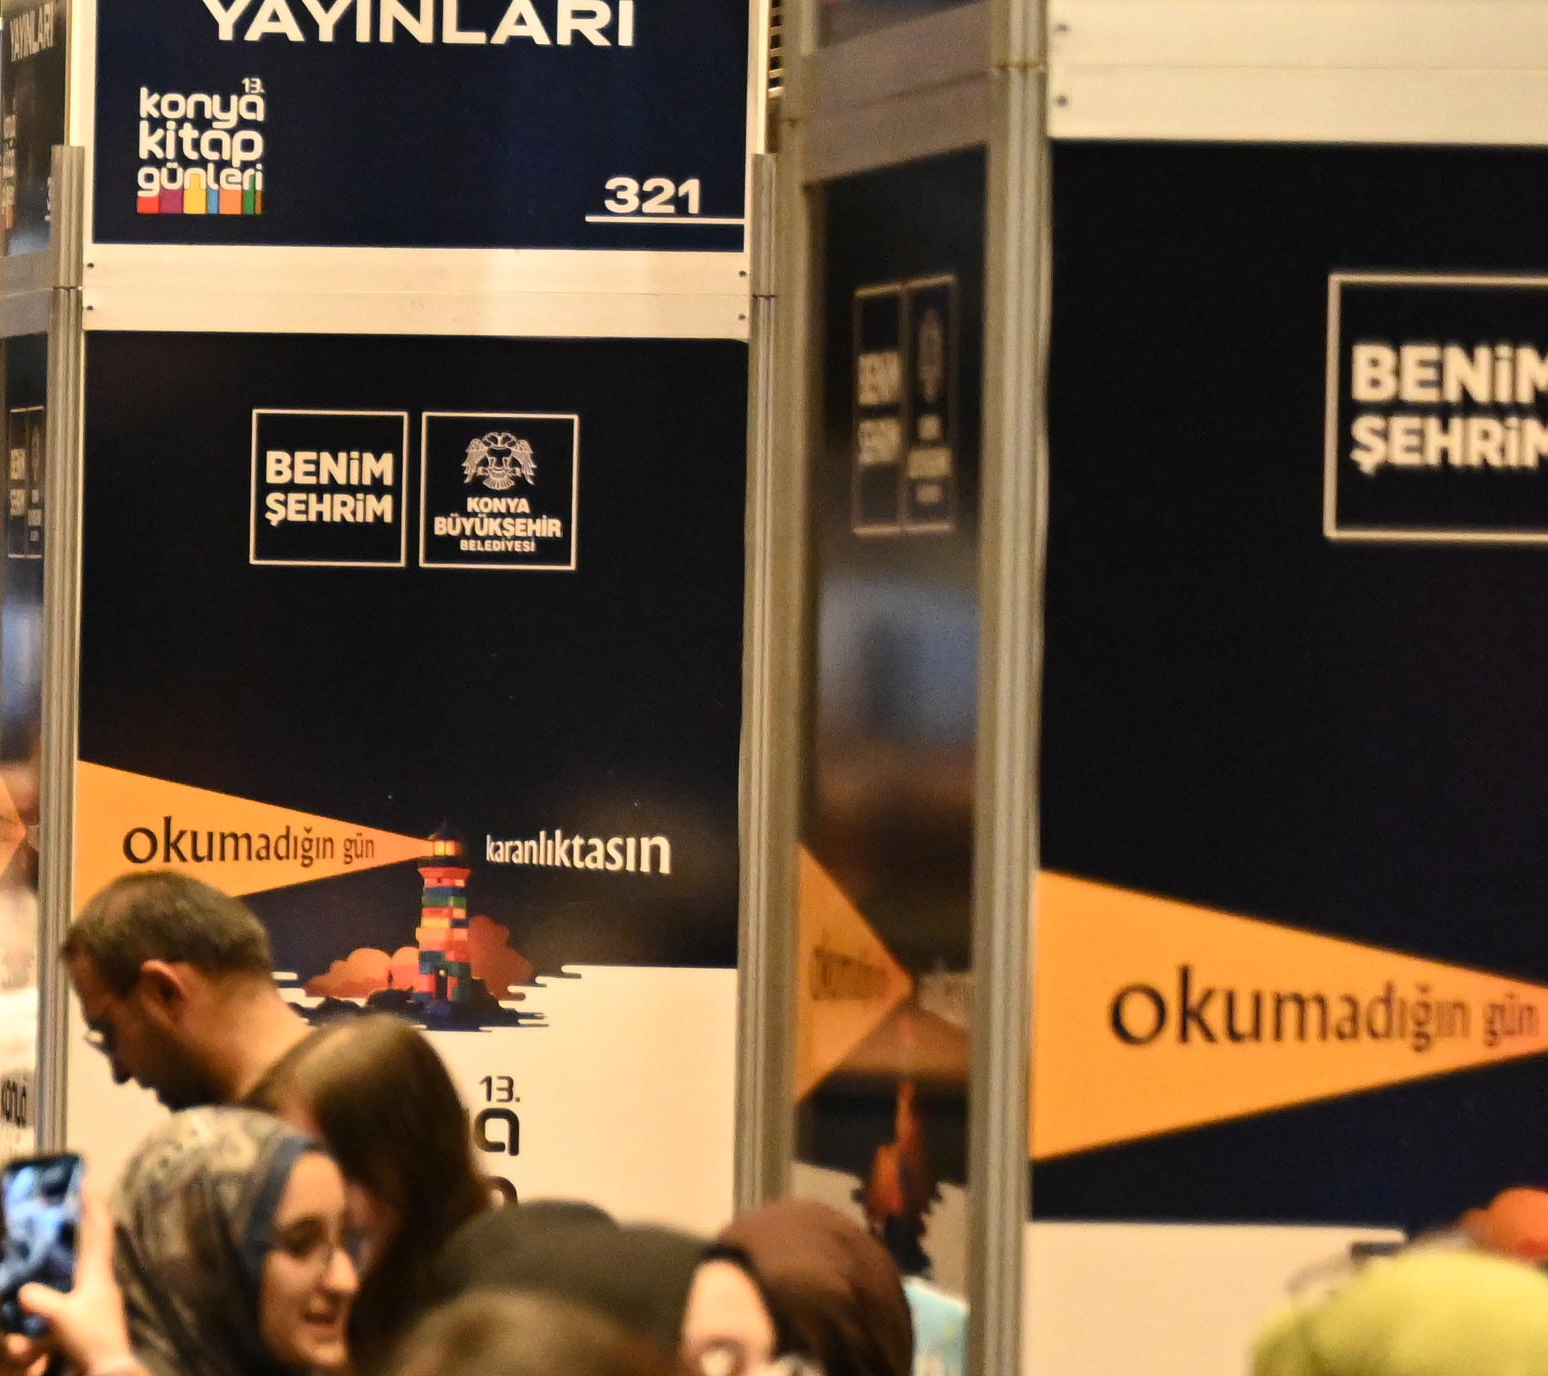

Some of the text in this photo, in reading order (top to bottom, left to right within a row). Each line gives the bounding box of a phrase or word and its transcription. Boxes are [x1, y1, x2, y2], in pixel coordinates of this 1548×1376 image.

[10, 1, 55, 64] YAYINLARI
[242, 78, 265, 93] 13.
[140, 86, 265, 129] konya
[139, 119, 263, 167] kitap
[138, 164, 263, 197] günleri
[604, 178, 701, 215] 321
[467, 498, 530, 513] KONYA
[434, 514, 562, 540] BÜYÜKŞEHİR
[460, 537, 536, 552] BELEDİYESİ
[122, 814, 672, 876] okumadığın gün karanlıktasın
[1108, 964, 1540, 1055] okumadığın gün
[479, 1075, 521, 1103] 13.
